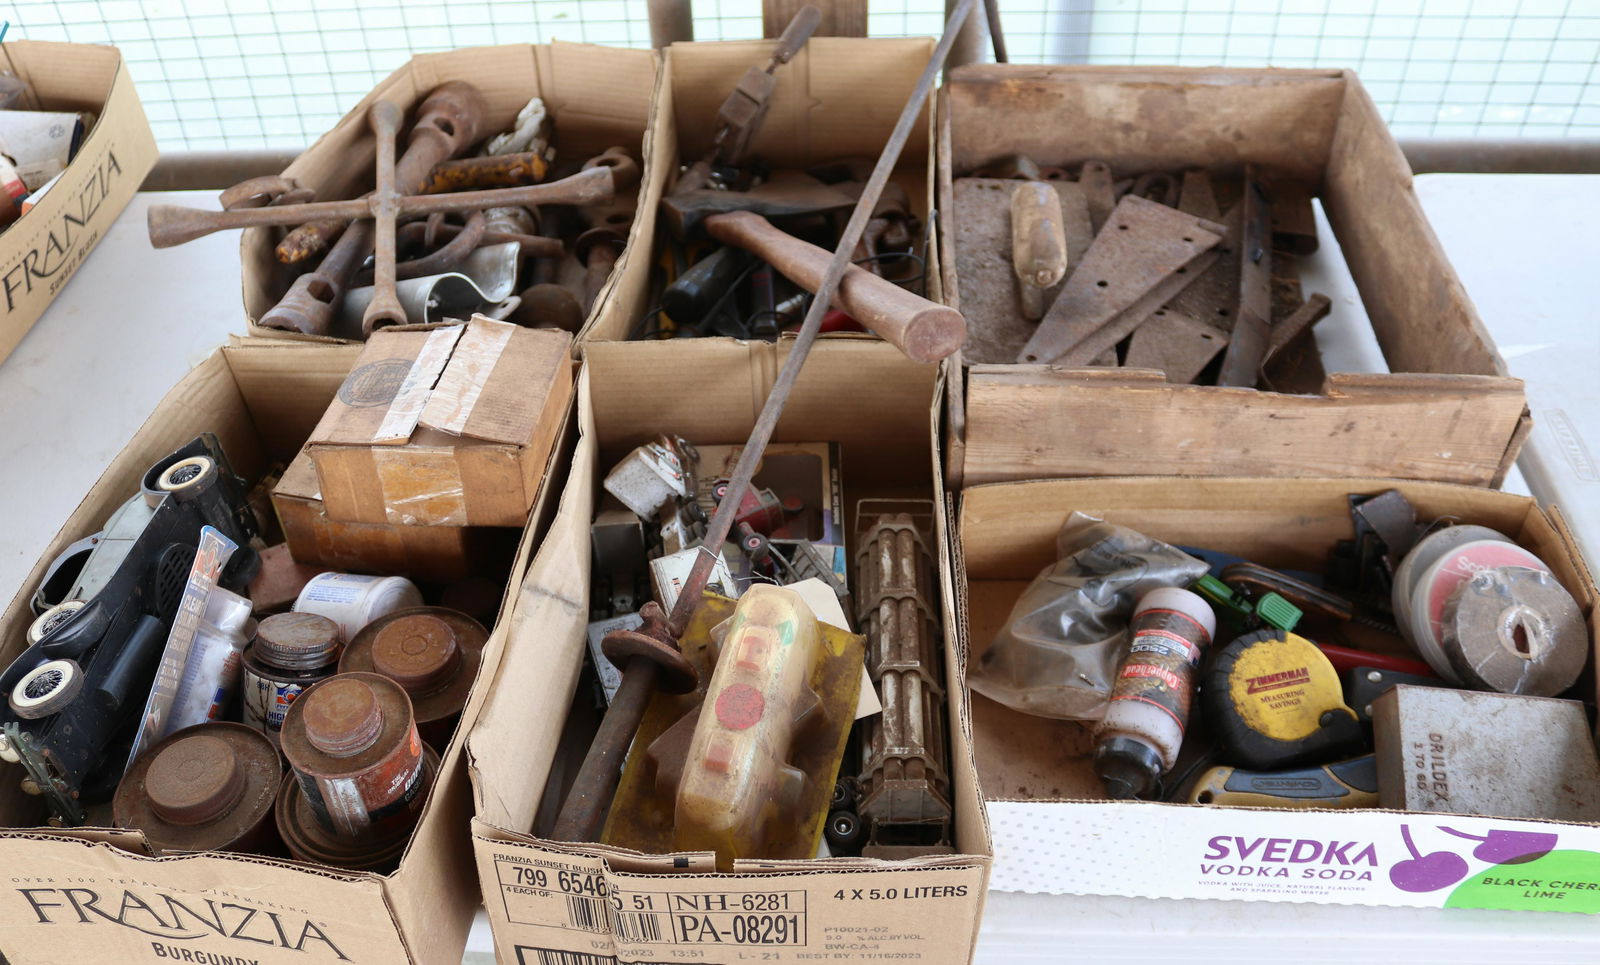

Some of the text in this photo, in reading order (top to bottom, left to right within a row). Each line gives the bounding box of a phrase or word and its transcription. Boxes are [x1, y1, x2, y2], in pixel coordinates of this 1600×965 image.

[2, 149, 122, 313] FRANZIA
[1130, 644, 1170, 655] 2500
[1124, 664, 1178, 690] Copperhead
[1246, 667, 1309, 694] ZIMMERMAN
[1260, 689, 1305, 703] MEASURING
[1270, 699, 1302, 709] SAVINGS
[1415, 753, 1425, 768] TO
[1429, 733, 1449, 801] DRILDEX
[1204, 835, 1379, 867] SVEDKA
[493, 853, 604, 875] FRANZIA SUNSET BLUSH
[1200, 864, 1373, 881] VODKA SODA
[512, 866, 548, 888] 799
[632, 895, 654, 910] 51
[513, 887, 537, 898] EACH
[540, 891, 553, 899] OF:
[834, 885, 968, 900] 4 X 5.0 LITERS
[1481, 877, 1600, 891] BLACK CHER
[675, 892, 789, 911] NH-6281
[1523, 890, 1567, 899] LIME
[16, 887, 353, 962] FRANZIA
[676, 914, 798, 944] PA-08291
